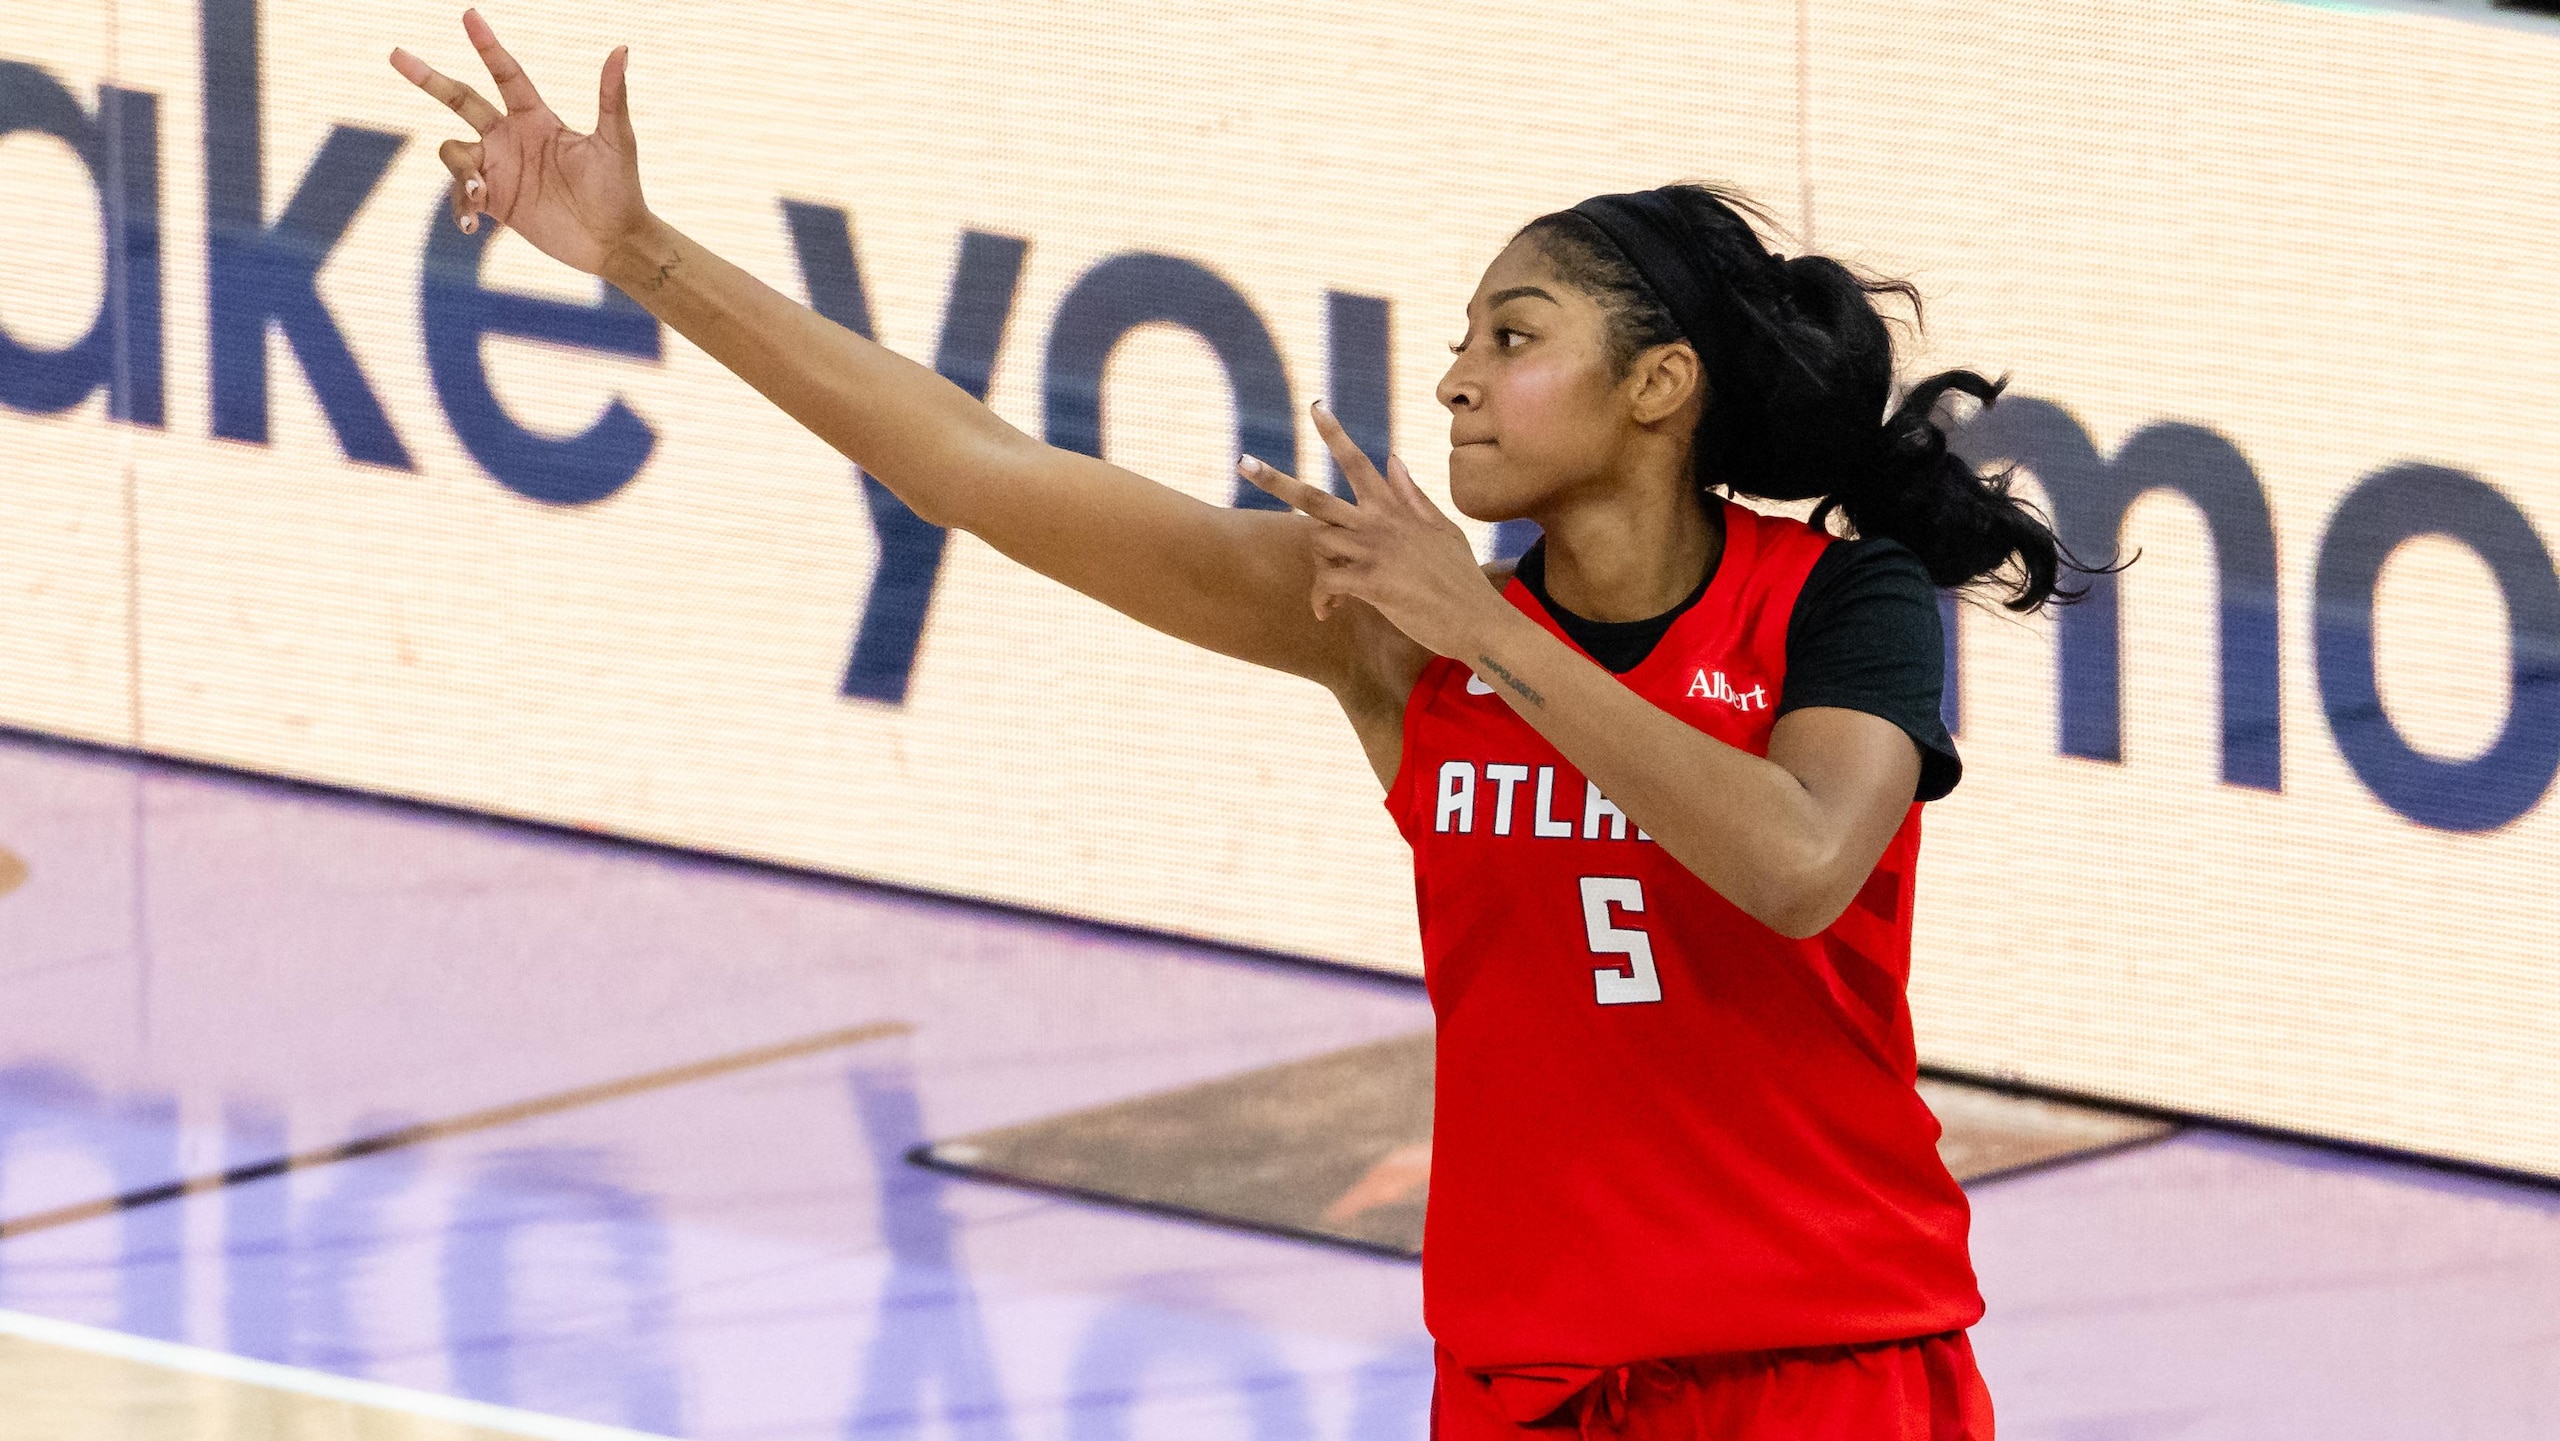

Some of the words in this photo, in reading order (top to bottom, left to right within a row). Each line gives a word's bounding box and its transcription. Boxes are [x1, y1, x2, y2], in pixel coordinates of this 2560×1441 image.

[1938, 395, 2560, 834] mo
[1686, 668, 1768, 711] Albert
[1435, 760, 1654, 841] ATLA
[1579, 876, 1662, 1005] 5
